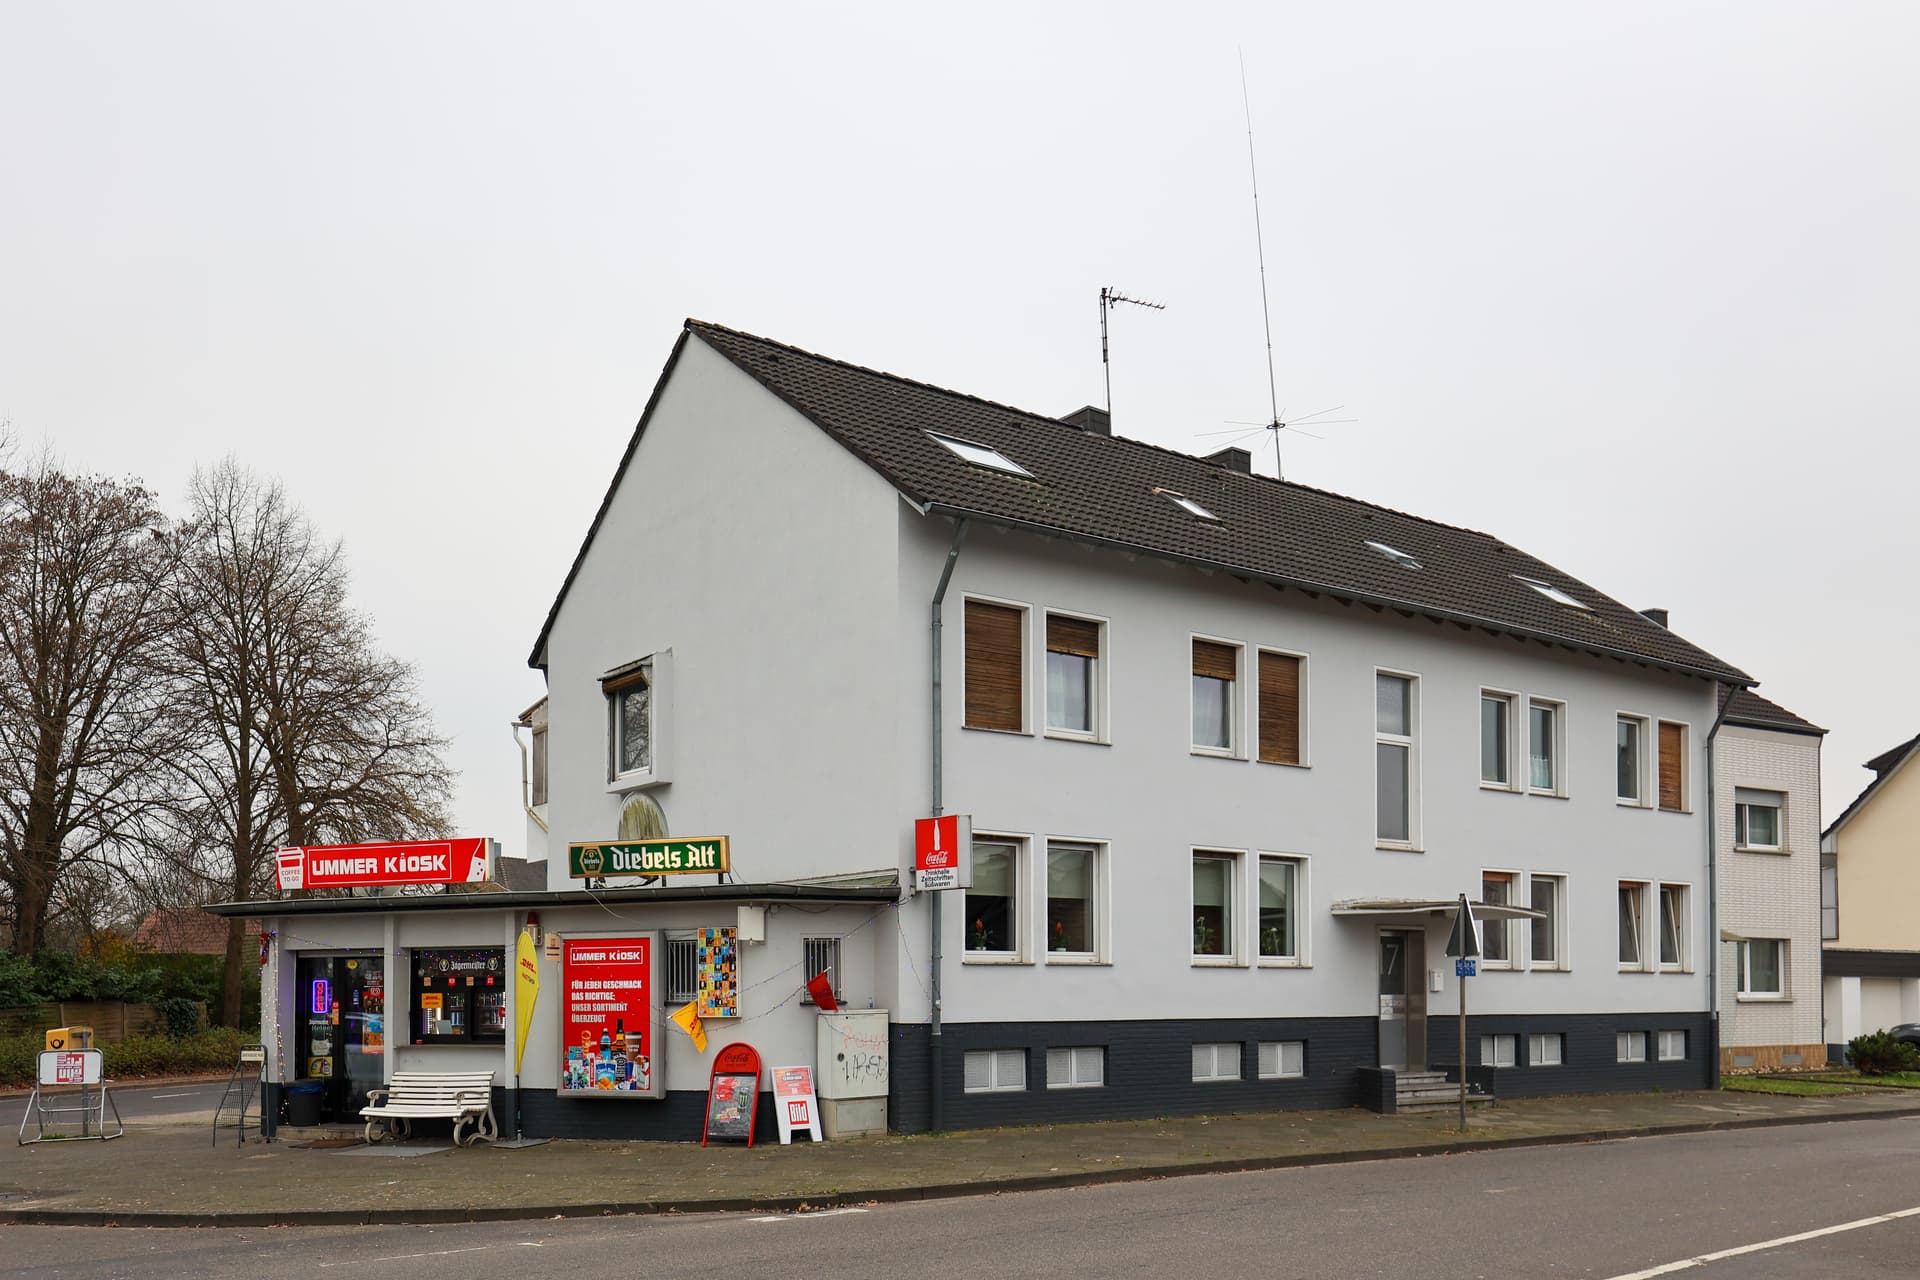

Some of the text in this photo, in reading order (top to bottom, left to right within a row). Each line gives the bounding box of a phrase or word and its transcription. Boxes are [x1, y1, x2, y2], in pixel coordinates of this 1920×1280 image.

[685, 843, 715, 868] Alt
[1386, 943, 1399, 976] 7
[572, 979, 642, 989] FÜR JEDEN GESCHMACK
[572, 992, 584, 1000] DAS
[572, 1003, 628, 1011] UNSER SORTIMENT
[572, 1013, 606, 1023] ÜBERZEUGT
[790, 1103, 808, 1122] Bild
